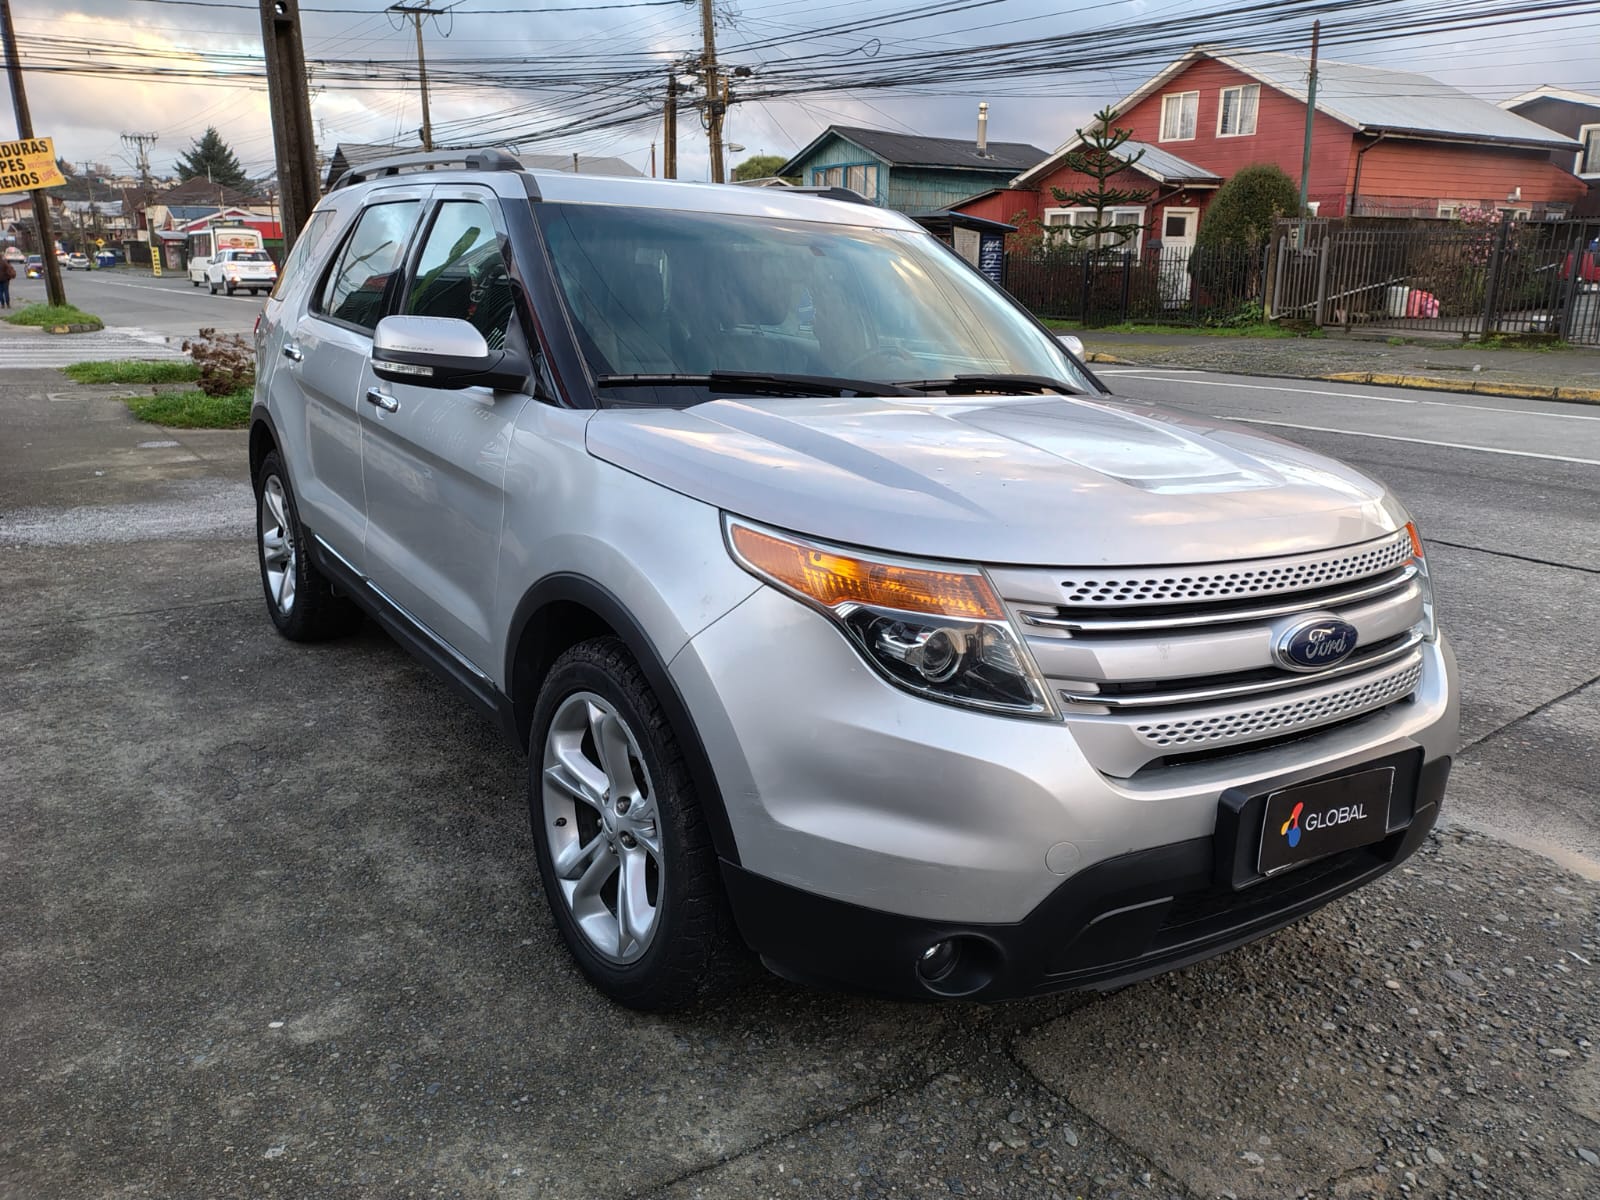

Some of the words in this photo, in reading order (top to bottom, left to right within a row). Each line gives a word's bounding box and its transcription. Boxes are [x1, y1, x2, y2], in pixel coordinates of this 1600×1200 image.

[0, 140, 48, 158] DURAS
[1305, 627, 1347, 659] Ford
[1305, 803, 1368, 831] GLOBAL
